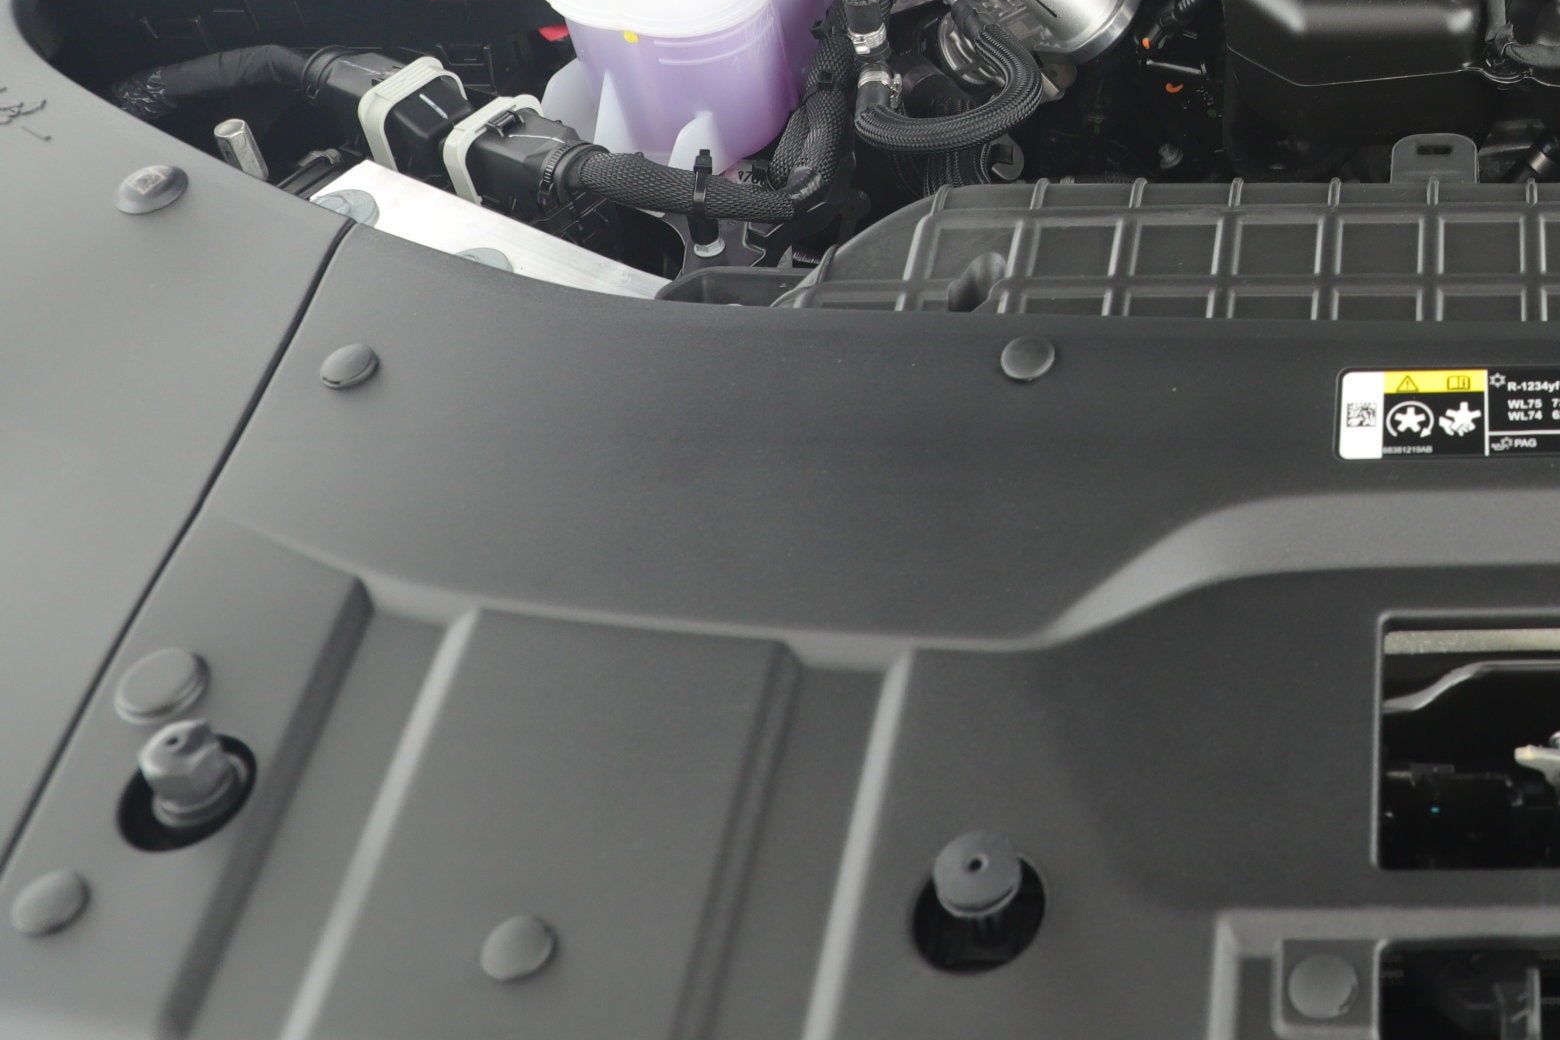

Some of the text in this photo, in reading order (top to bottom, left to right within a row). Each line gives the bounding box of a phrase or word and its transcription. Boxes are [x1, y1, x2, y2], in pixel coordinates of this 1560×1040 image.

[1507, 381, 1560, 393] R-1234yf
[1507, 399, 1542, 409] WL75
[1508, 411, 1543, 421] WL74
[1514, 438, 1537, 448] PAG
